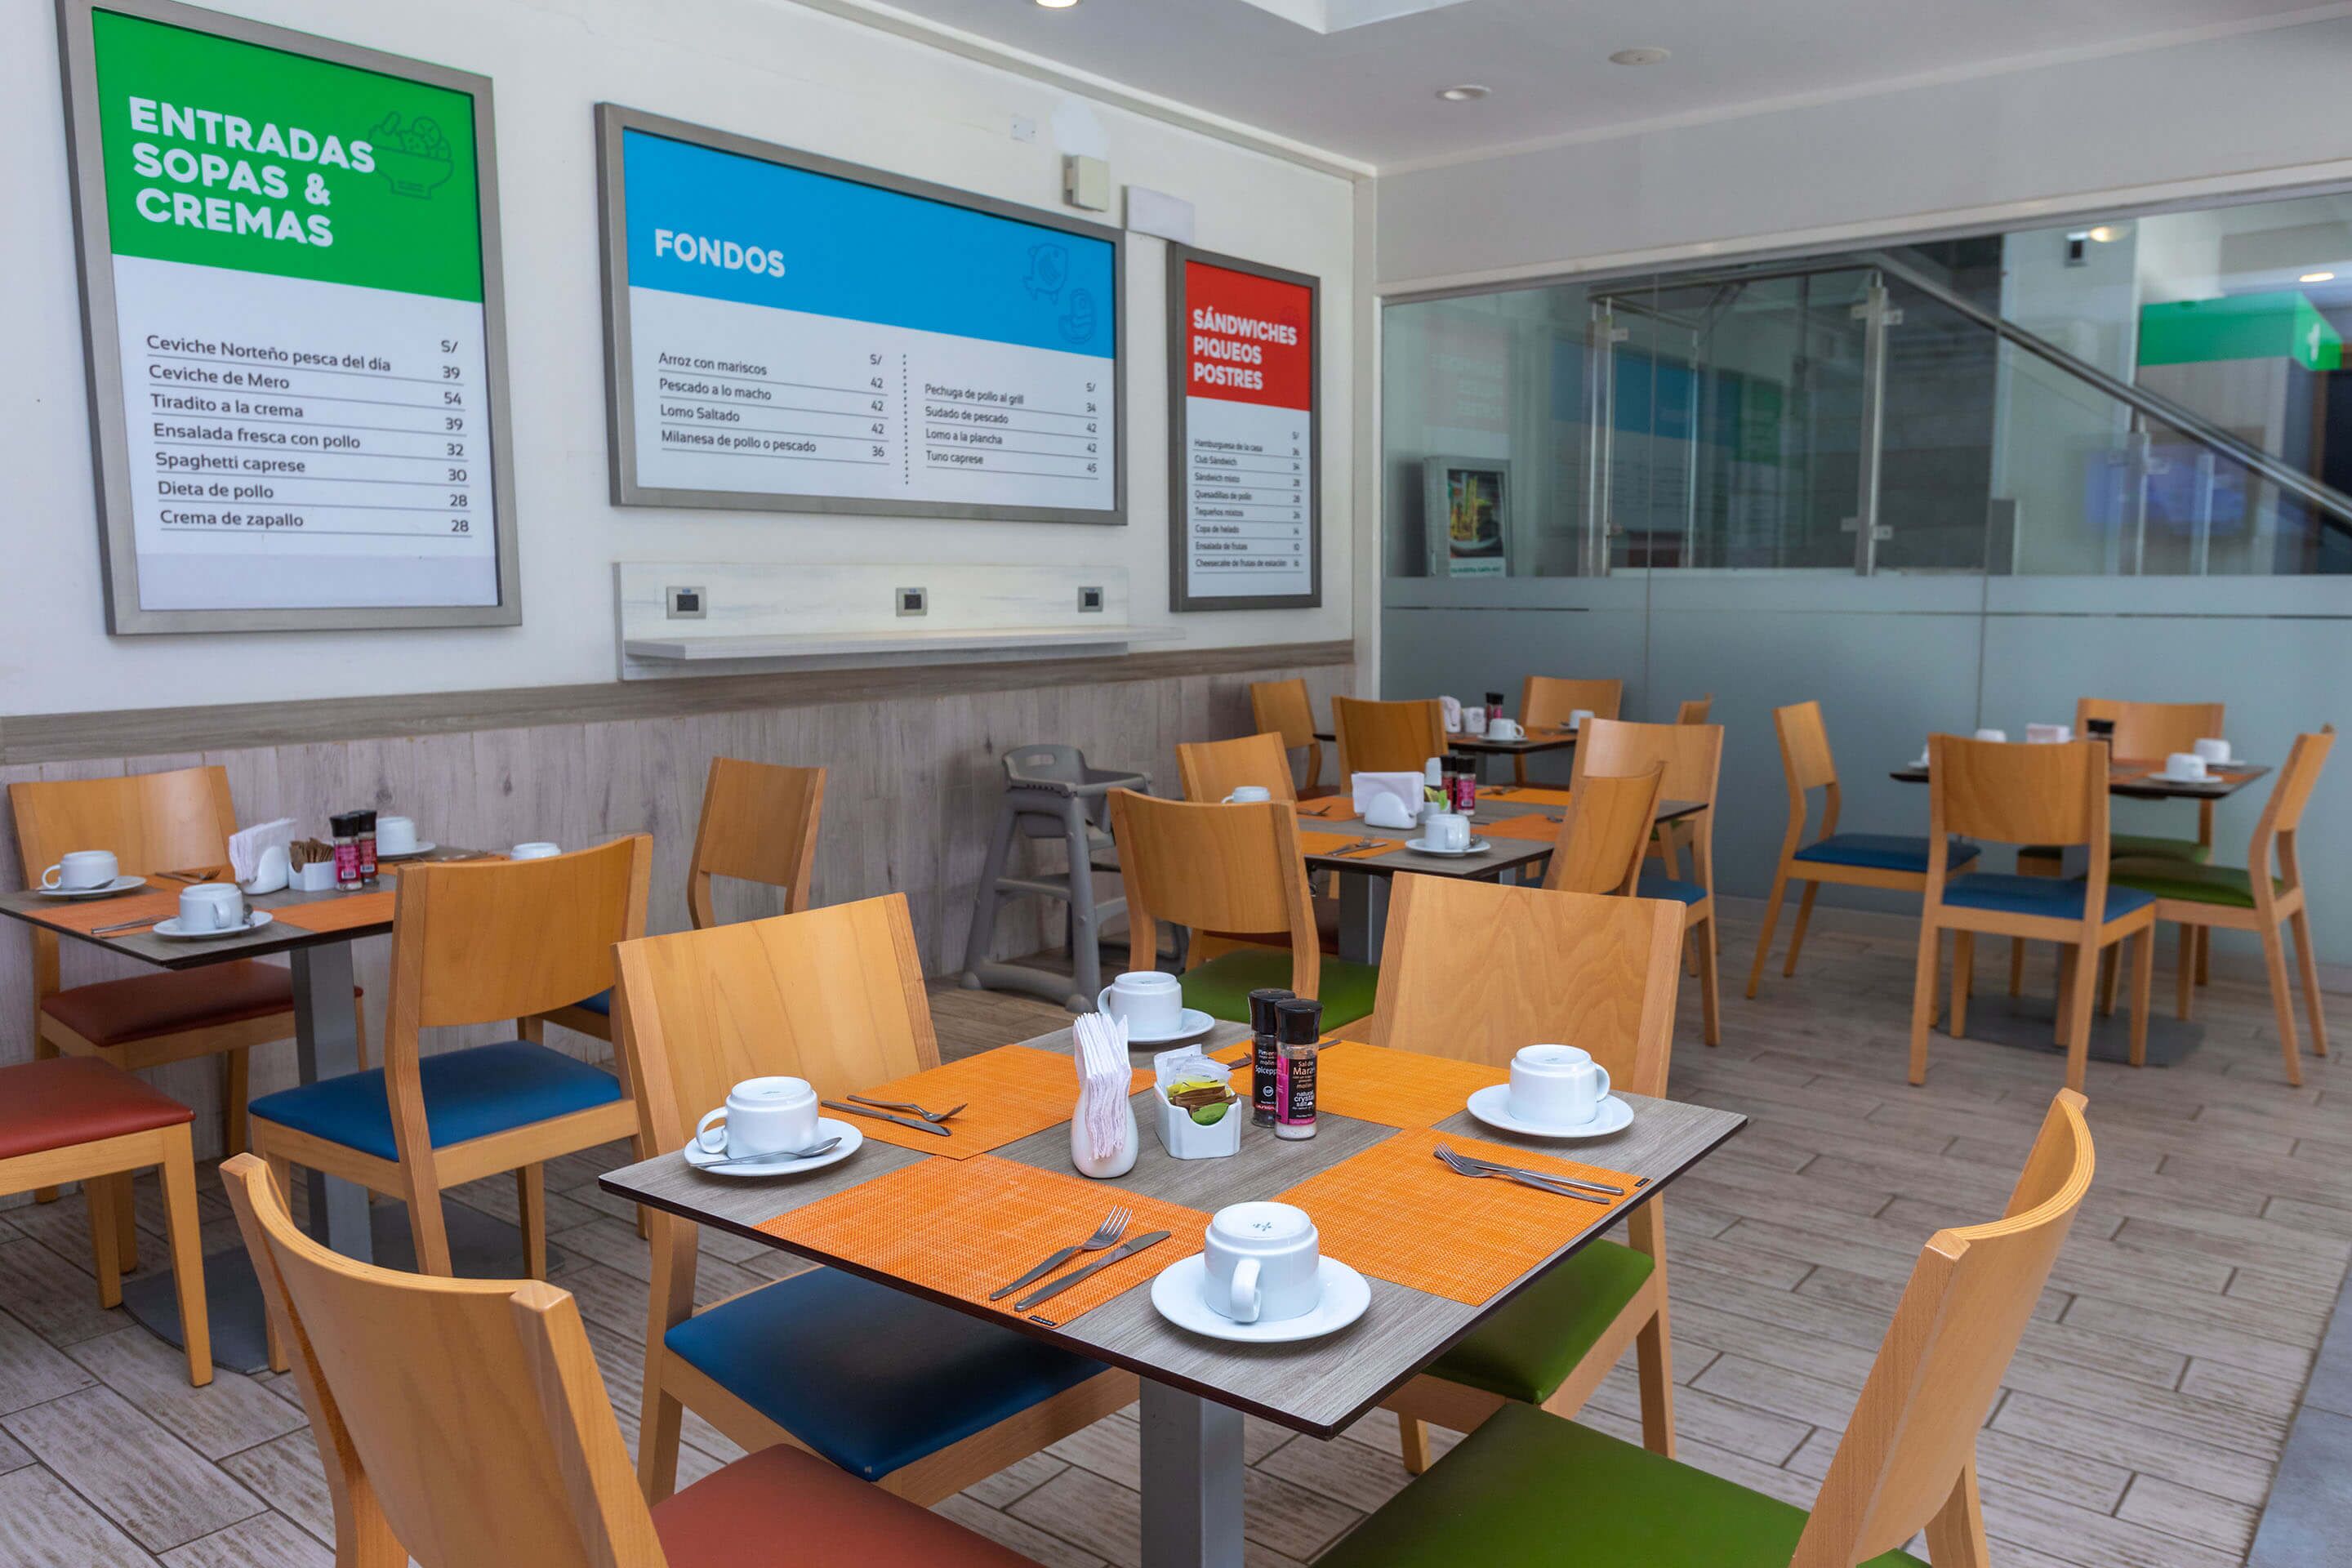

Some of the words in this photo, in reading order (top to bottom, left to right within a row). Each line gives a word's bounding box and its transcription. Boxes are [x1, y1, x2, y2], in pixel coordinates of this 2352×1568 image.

[128, 96, 376, 173] ENTRADAS
[132, 142, 289, 198] SOPAS
[305, 173, 331, 206] &
[136, 187, 334, 247] CREMAS
[655, 228, 786, 278] FONDOS
[1193, 305, 1298, 346] SÁNDWICHES
[147, 335, 216, 354] Ceviche
[221, 341, 288, 362] Norteño
[293, 352, 338, 365] pesca
[342, 354, 364, 368] del
[368, 358, 391, 372] día
[442, 365, 461, 380] 39
[441, 340, 458, 354] S/
[870, 354, 883, 366] S/
[1193, 336, 1263, 365] PIQUEOS
[149, 364, 218, 383] Ceviche
[223, 371, 243, 385] de
[248, 373, 290, 390] Mero
[443, 391, 462, 406] 54
[658, 352, 691, 367] Arroz
[694, 358, 715, 369] con
[718, 360, 768, 376] mariscos
[871, 377, 884, 389] 42
[1193, 362, 1263, 390] POSTRES
[660, 377, 709, 394] Pescado
[712, 386, 719, 395] a
[722, 384, 732, 396] lo
[735, 387, 772, 400] macho
[871, 400, 884, 412] 42
[924, 383, 963, 399] Pechuga
[964, 389, 975, 399] de
[978, 391, 998, 402] pollo
[1000, 392, 1007, 402] al
[1009, 394, 1024, 406] grill
[1086, 382, 1096, 392] S/
[150, 393, 216, 412] Tiradito
[221, 402, 231, 412] a
[236, 400, 249, 414] la
[254, 403, 303, 418] crema
[445, 417, 463, 432] 39
[661, 404, 693, 418] Lomo
[697, 408, 740, 422] Saltado
[871, 423, 884, 434] 42
[925, 406, 960, 419] Sudado
[961, 410, 972, 420] de
[973, 413, 1009, 424] pescado
[1086, 423, 1097, 433] 42
[154, 423, 233, 441] Ensalada
[238, 428, 286, 443] fresca
[291, 434, 318, 446] con
[323, 435, 360, 449] pollo
[447, 443, 464, 457] 32
[662, 430, 714, 445] Milanesa
[717, 434, 731, 446] de
[734, 436, 761, 449] pollo
[764, 439, 770, 448] o
[773, 439, 817, 452] pescado
[872, 446, 884, 457] 36
[925, 428, 951, 440] Lomo
[953, 432, 958, 441] a
[960, 431, 968, 441] la
[969, 432, 1003, 444] plancha
[1087, 443, 1097, 453] 42
[156, 452, 238, 470] Spaghetti
[243, 460, 305, 473] caprese
[448, 469, 467, 483] 30
[951, 454, 983, 465] caprese
[158, 481, 204, 496] Dieta
[208, 483, 229, 497] de
[234, 484, 274, 500] pollo
[449, 495, 468, 508] 28
[160, 510, 216, 525] Crema
[221, 511, 242, 525] de
[247, 514, 304, 528] zapallo
[451, 520, 470, 533] 28
